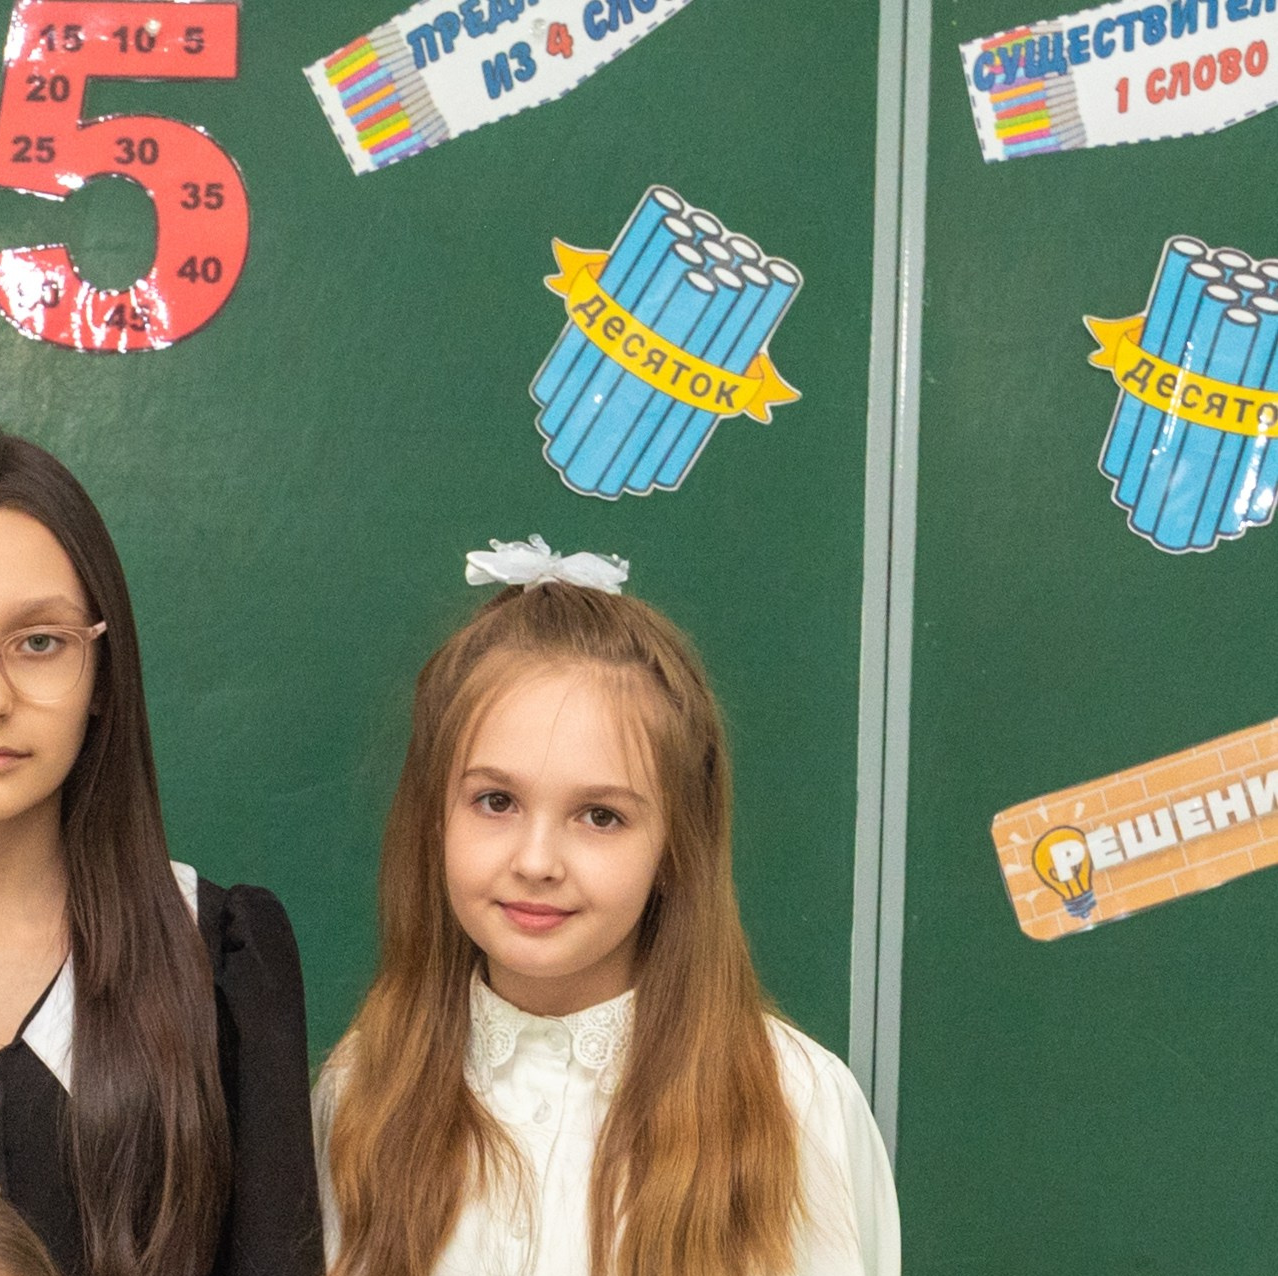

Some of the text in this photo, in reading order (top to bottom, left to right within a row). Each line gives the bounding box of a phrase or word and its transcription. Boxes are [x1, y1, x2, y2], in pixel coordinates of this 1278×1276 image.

[40, 24, 205, 55] 15 10 5
[481, 41, 537, 99] ИЗ
[546, 22, 574, 59] 4
[26, 75, 70, 102] 20
[1115, 39, 1269, 114] 1 СЛОВО
[11, 136, 159, 165] 25 30
[180, 182, 225, 210] 35
[177, 256, 222, 284] 40
[1049, 769, 1278, 883] РЕШЕНИ
